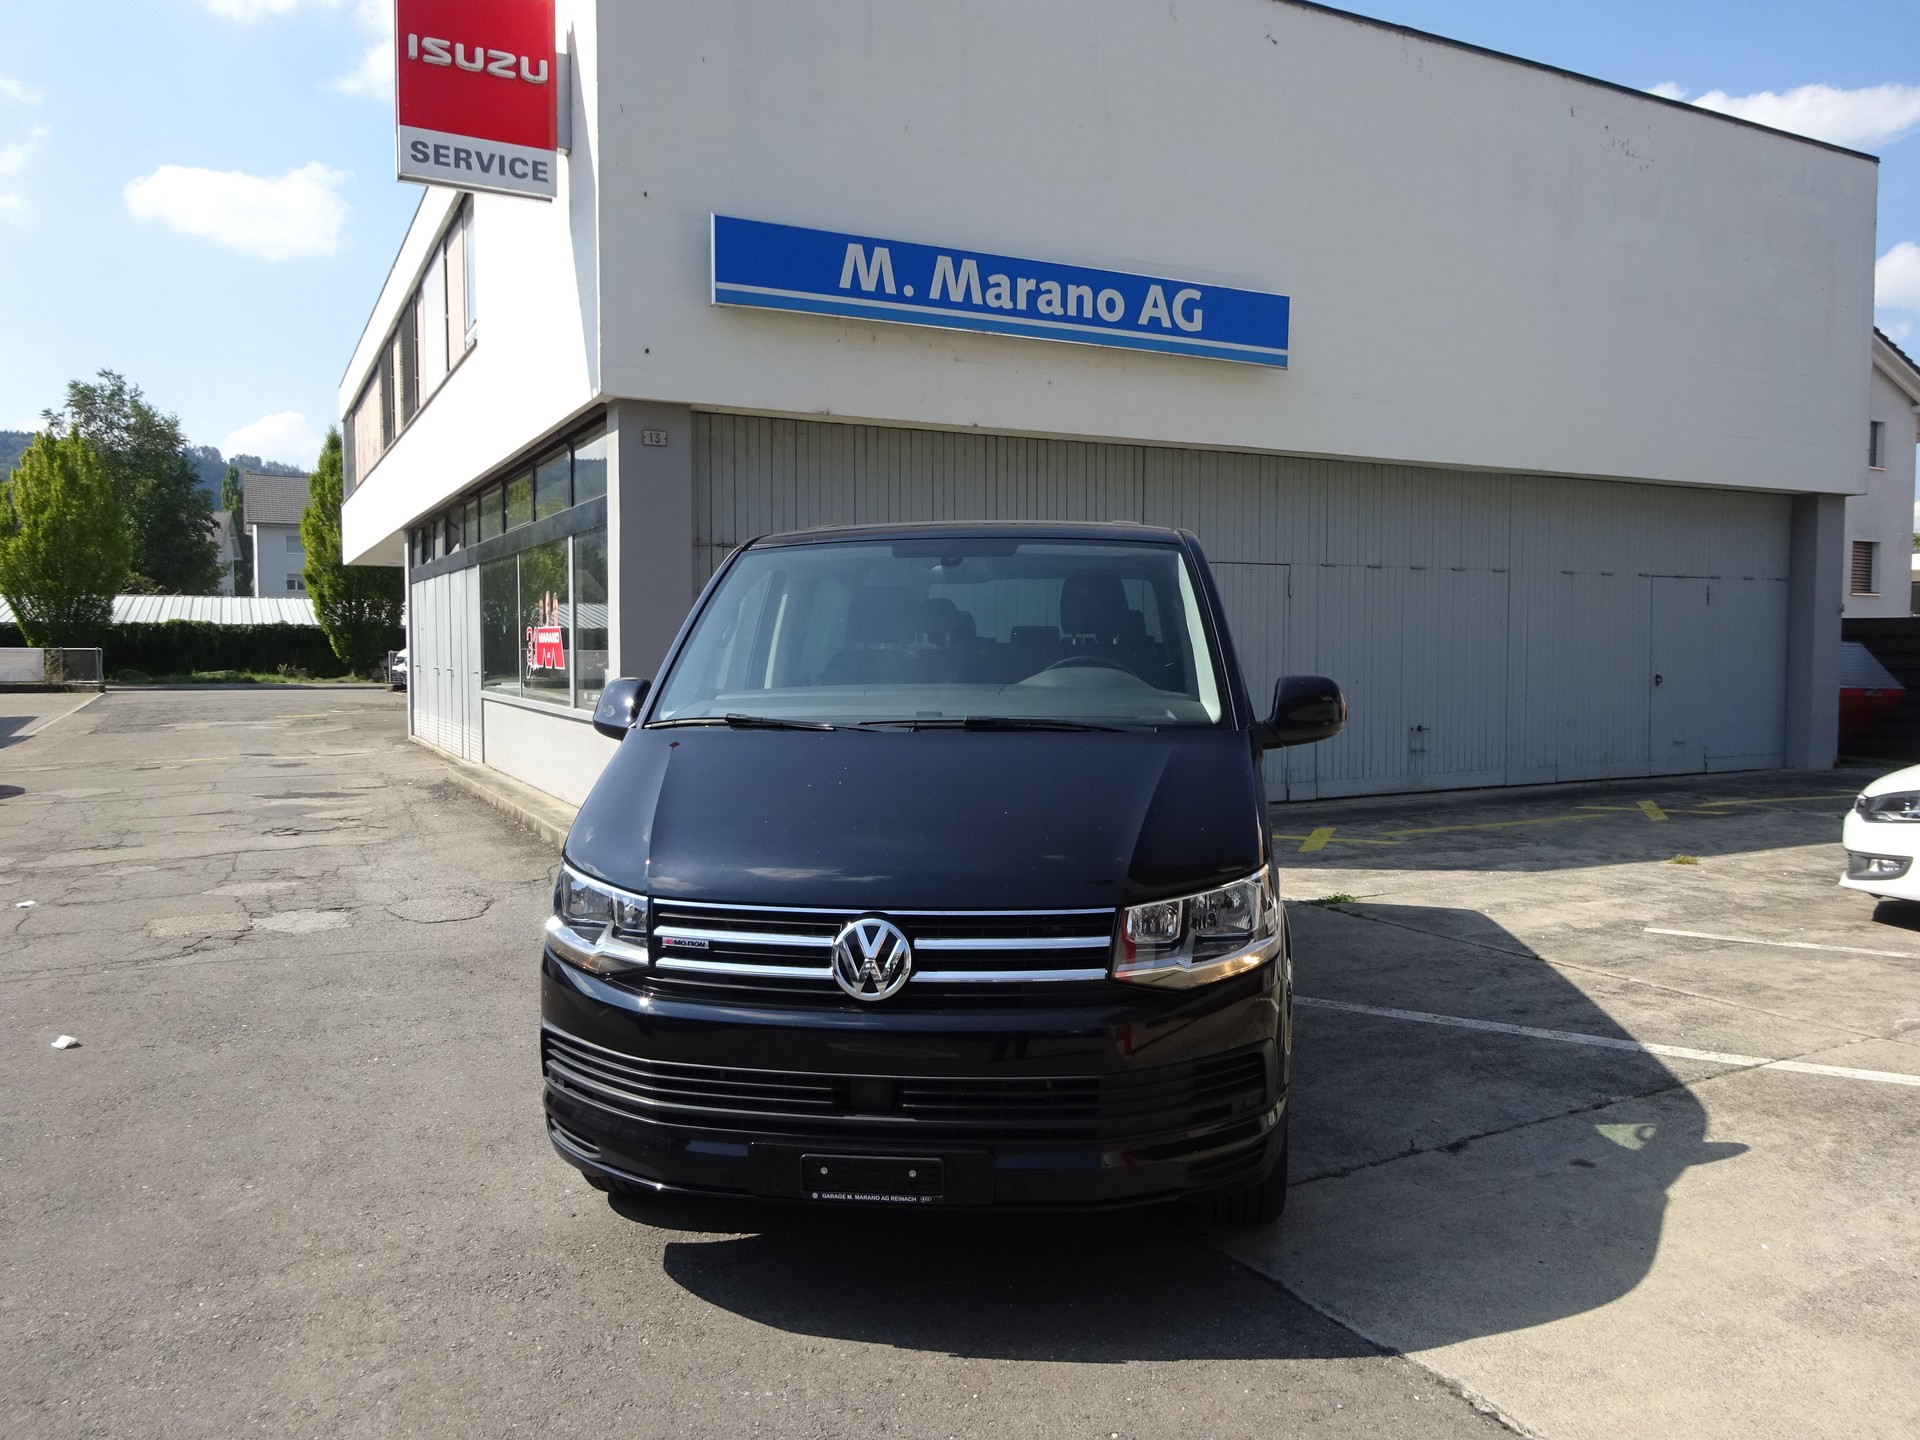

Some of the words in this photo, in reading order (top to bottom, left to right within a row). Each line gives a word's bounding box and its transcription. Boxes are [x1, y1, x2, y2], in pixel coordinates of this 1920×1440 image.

[407, 33, 548, 84] ISUZU
[410, 140, 549, 183] SERVICE
[839, 242, 914, 297] M.
[929, 254, 1125, 323] Marano
[1137, 285, 1204, 332] AG
[648, 432, 661, 444] 13
[538, 631, 559, 643] MARANO
